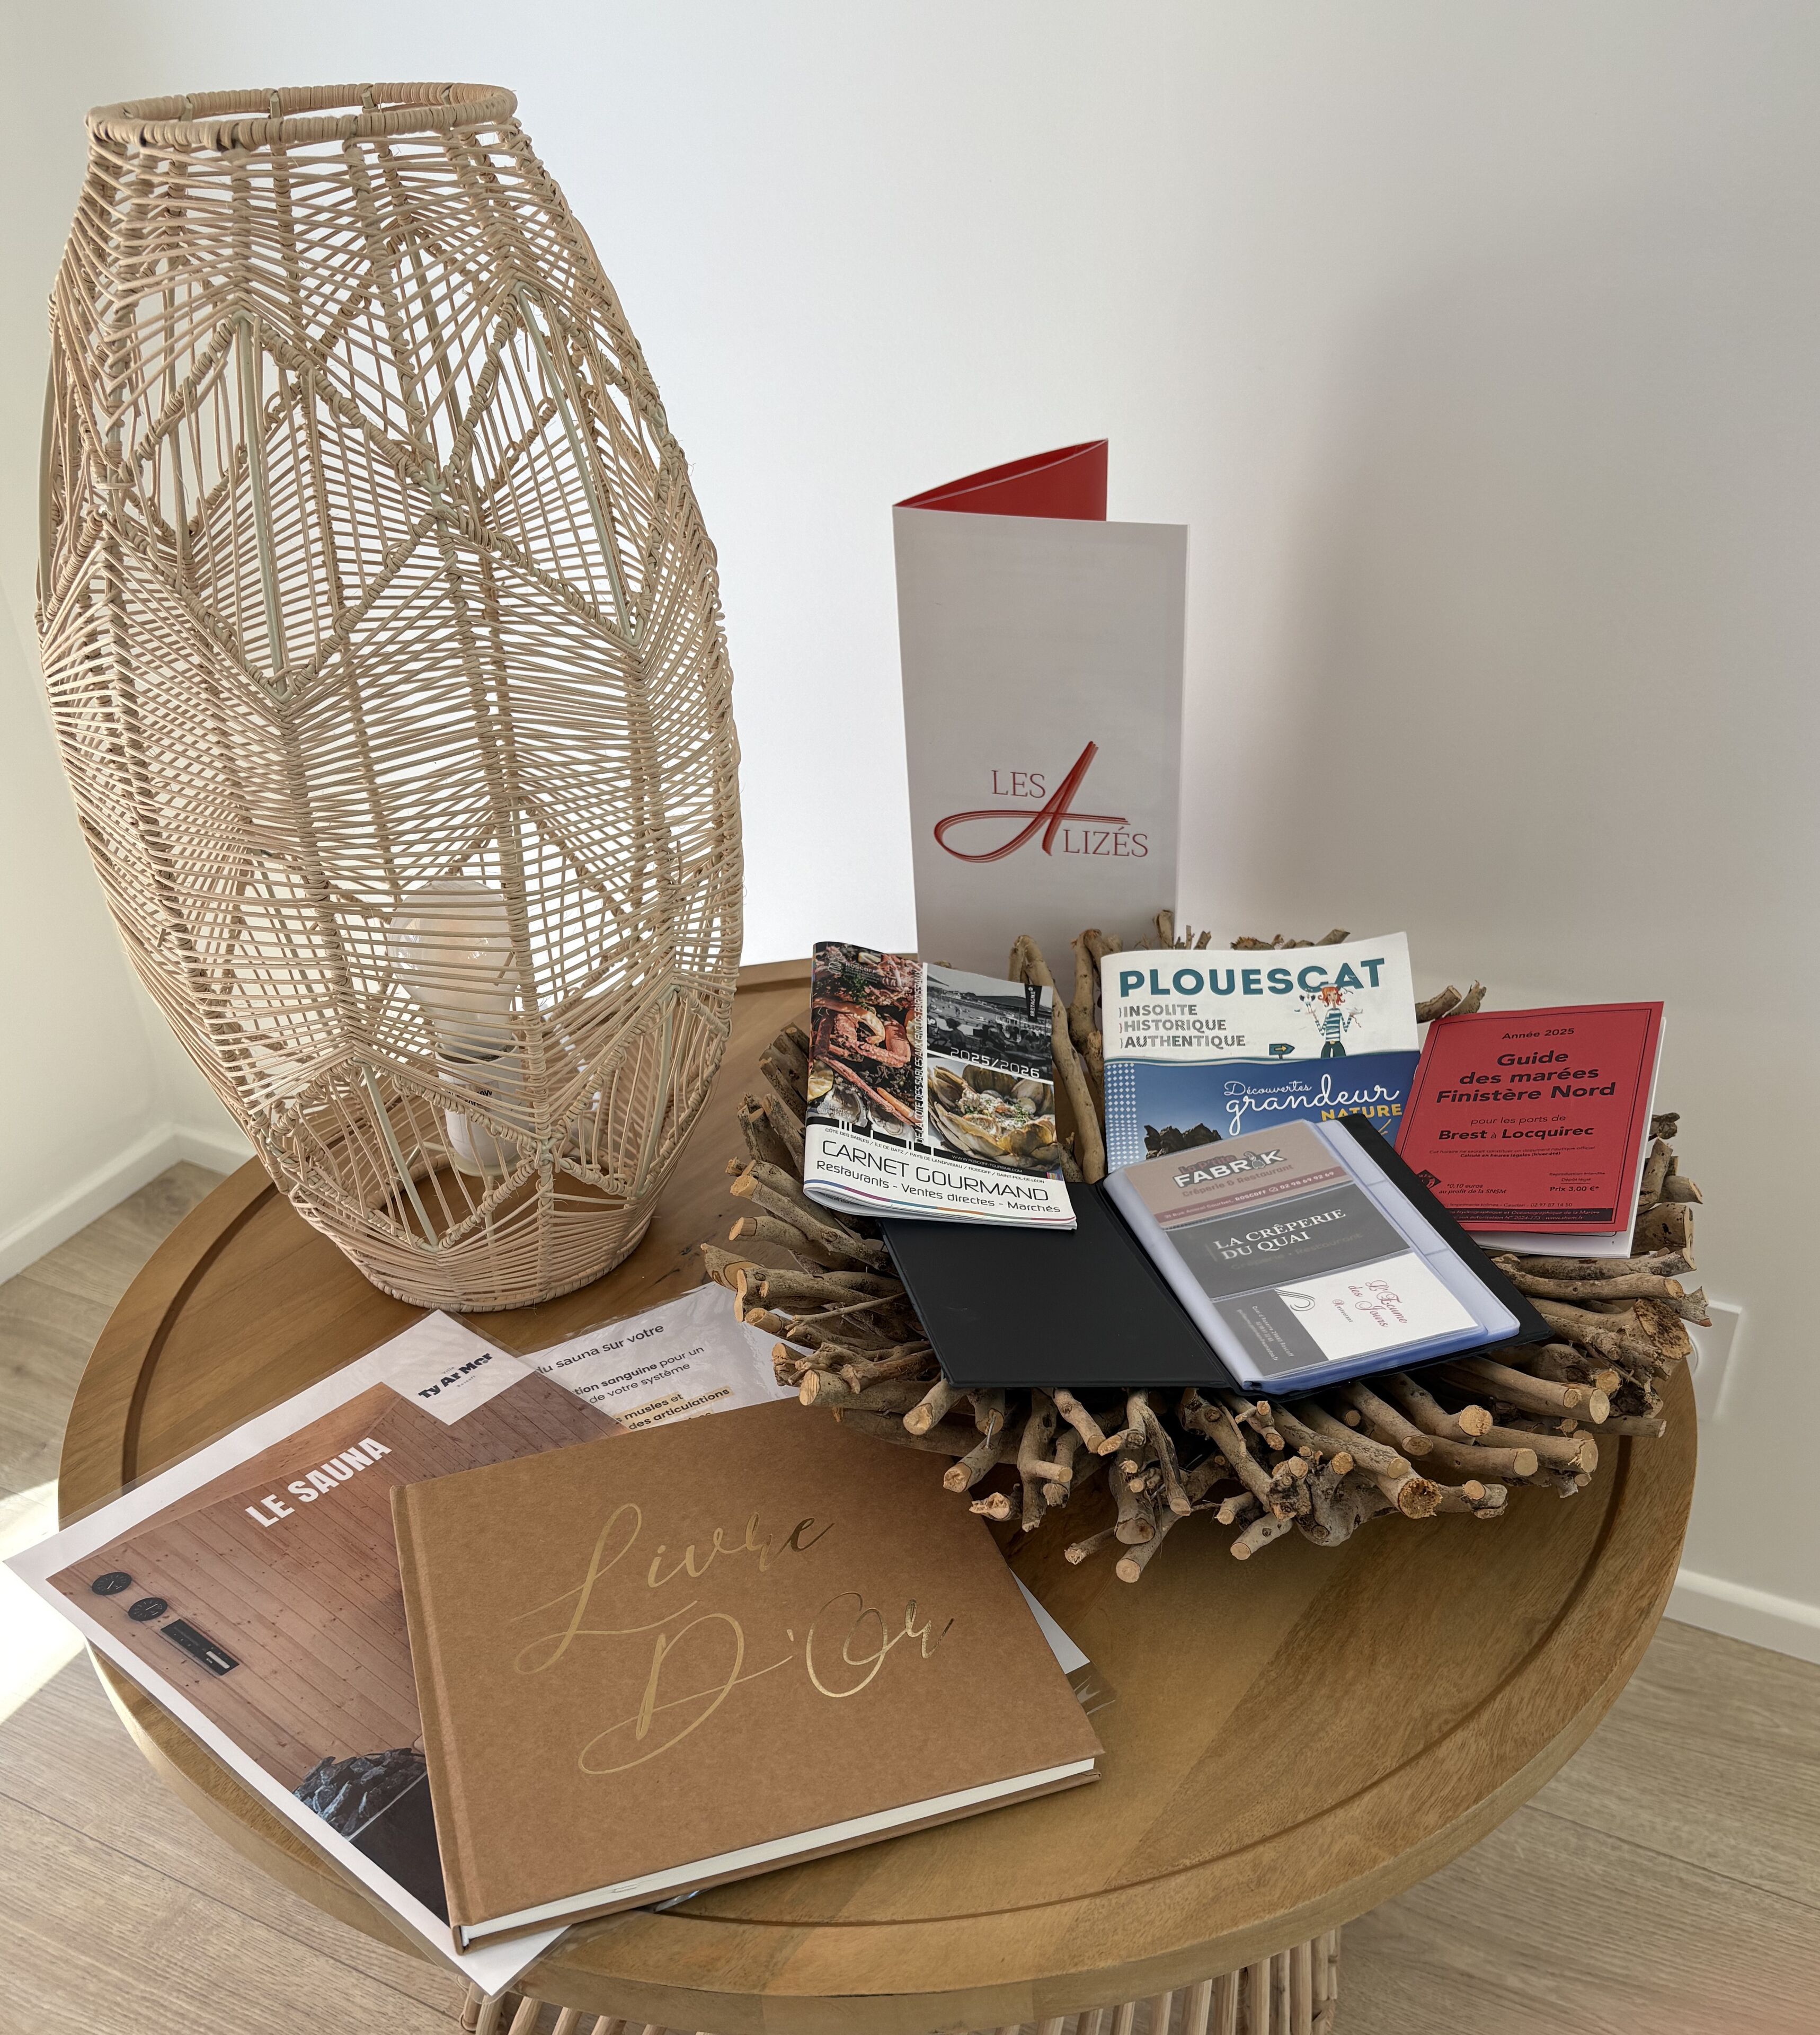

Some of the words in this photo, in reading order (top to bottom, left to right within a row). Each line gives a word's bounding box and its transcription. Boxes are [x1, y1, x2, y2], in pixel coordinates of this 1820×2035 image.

[991, 769, 1046, 798] LES
[1120, 958, 1384, 998] PLOUESCAT
[1502, 1031, 1540, 1040] Année
[1544, 1028, 1575, 1037] 2025
[915, 1040, 924, 1058] AUX
[951, 1047, 1040, 1078] 2025/2026
[1497, 1050, 1568, 1066] Guide
[915, 1057, 924, 1086] SABLES
[1459, 1072, 1502, 1085] des
[1510, 1067, 1599, 1083] marées
[915, 1086, 924, 1102] DES
[1224, 1081, 1312, 1096] Découvertes
[1436, 1089, 1541, 1103] Finistère
[1550, 1082, 1616, 1099] Nord
[1226, 1073, 1400, 1136] grandeur
[1439, 1130, 1487, 1140] Brest
[1502, 1126, 1594, 1140] Locquirec
[1519, 1117, 1548, 1125] ports
[822, 1140, 910, 1178] CARNET
[916, 1166, 1049, 1201] GOURMAND
[1237, 1164, 1294, 1183] Restaurant
[816, 1160, 890, 1189] Restaurants
[901, 1183, 943, 1200] Ventes
[947, 1193, 995, 1207] directes
[1007, 1201, 1061, 1213] Marchés
[1235, 1190, 1266, 1201] ROSCOFF
[1213, 1237, 1244, 1250] LA
[1246, 1209, 1346, 1241] CRÊPERIE
[1221, 1245, 1253, 1260] DU
[1257, 1231, 1312, 1252] QUAI
[1348, 1286, 1363, 1297] des
[1355, 1300, 1389, 1328] Jours
[556, 1348, 600, 1368] sauna
[602, 1340, 624, 1352] sur
[627, 1325, 664, 1343] votre
[418, 1384, 441, 1399] Ty
[440, 1372, 461, 1387] Ar
[573, 1383, 599, 1395] tion
[601, 1363, 658, 1387] sanguine
[659, 1352, 686, 1368] pour
[688, 1347, 705, 1356] un
[589, 1394, 605, 1404] de
[607, 1382, 638, 1396] votre
[641, 1363, 691, 1385] système
[624, 1400, 669, 1420] musles
[671, 1394, 684, 1403] et
[628, 1418, 652, 1430] des
[653, 1388, 730, 1421] articulations
[244, 1493, 296, 1528] LE
[287, 1437, 393, 1502] SAUNA
[511, 1503, 834, 1675] Livre
[578, 1591, 954, 1774] D'Or
